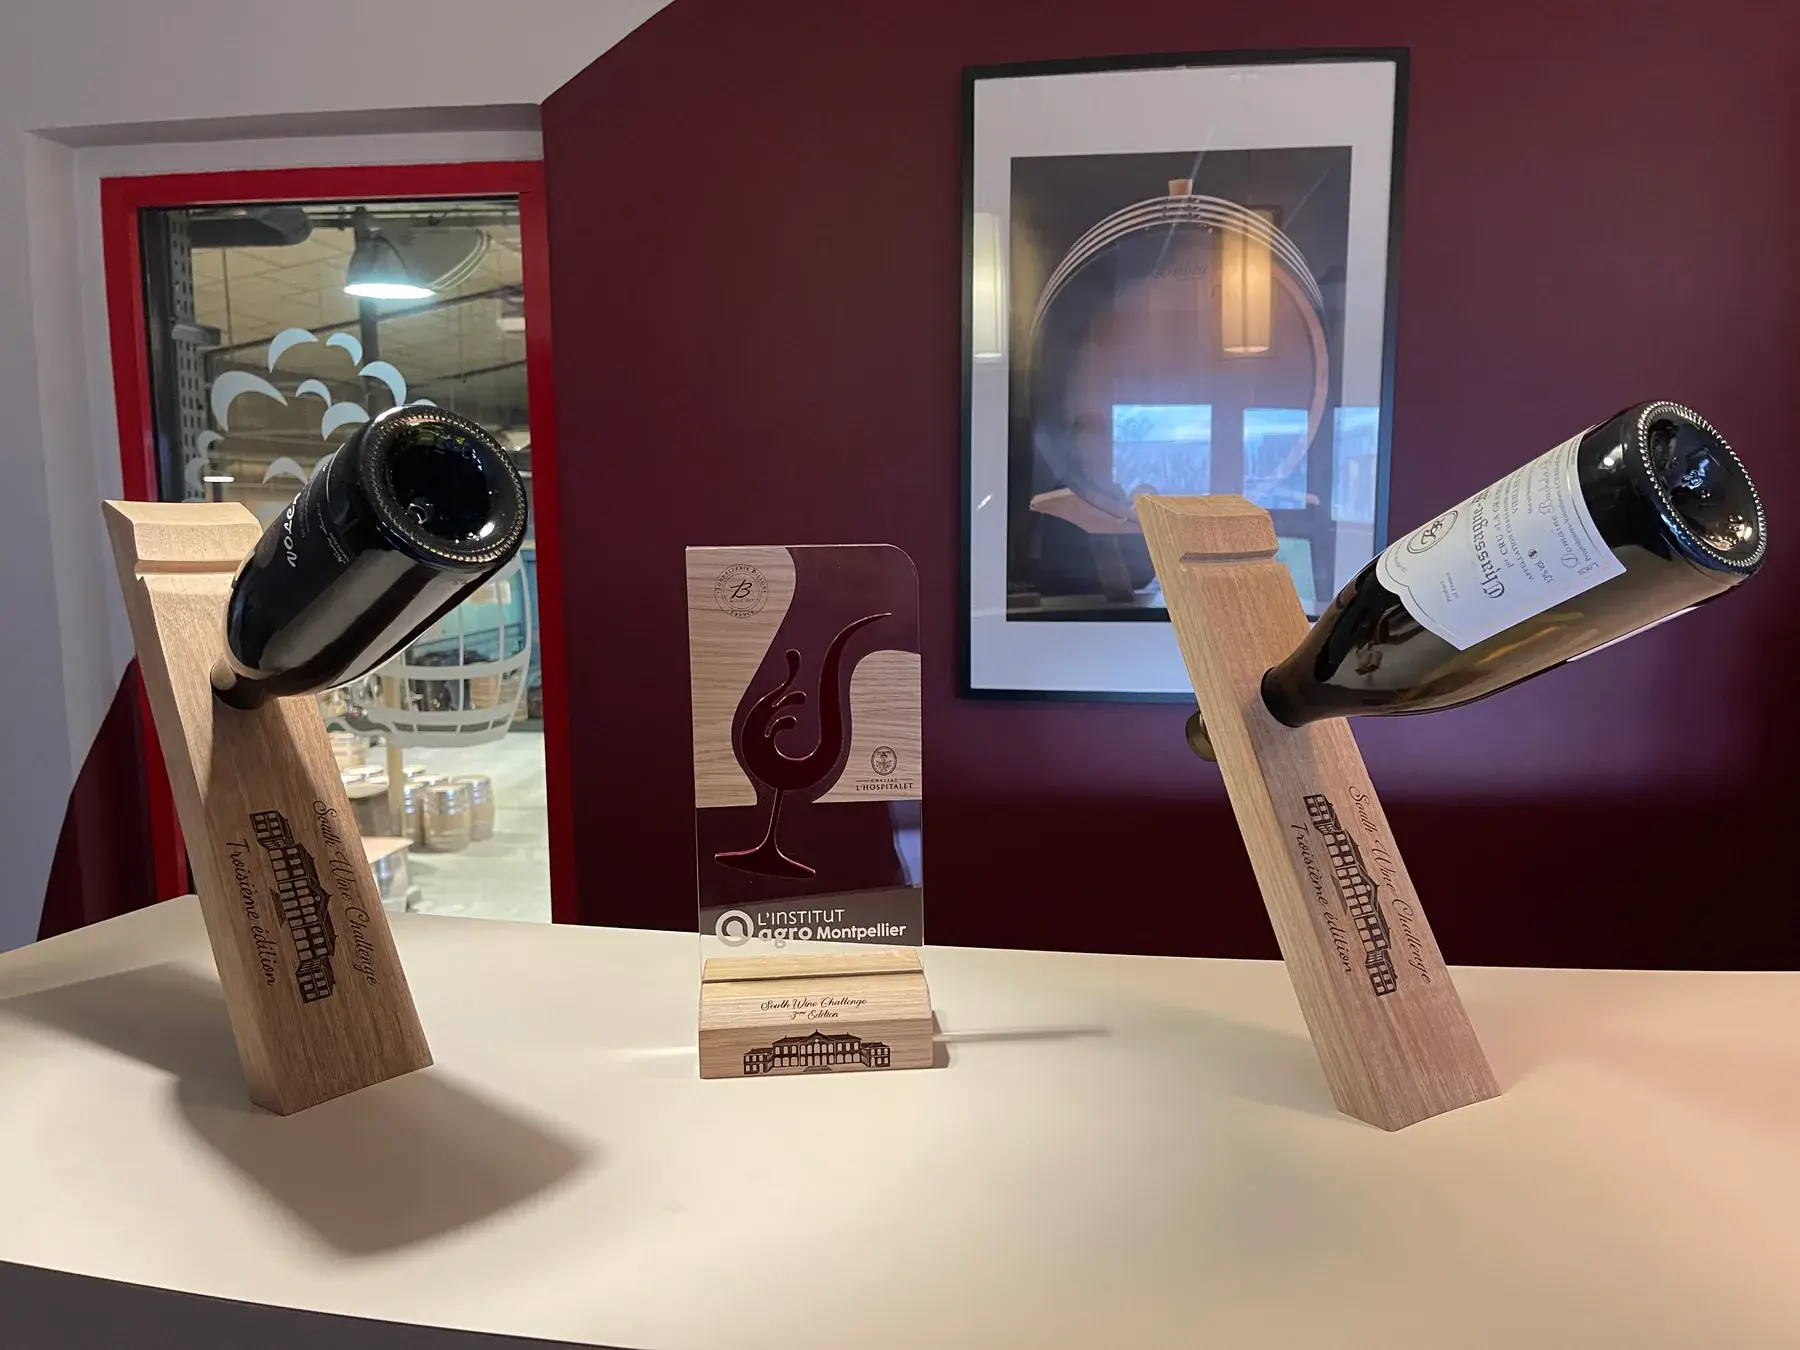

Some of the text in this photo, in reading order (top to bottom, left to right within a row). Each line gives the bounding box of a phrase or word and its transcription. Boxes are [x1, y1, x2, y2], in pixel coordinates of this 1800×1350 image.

[1495, 532, 1509, 556] CRU
[1546, 514, 1581, 570] Domaine
[730, 579, 753, 599] B
[856, 782, 914, 791] L'HOSPITALET
[313, 800, 378, 987] South Wine Challenge
[1291, 821, 1353, 975] Troisième édition
[1348, 785, 1431, 984] South Wine Challenge
[226, 838, 277, 987] Troisième édition
[758, 923, 907, 949] agro Montpellier
[760, 996, 867, 1011] South Wine Challenge
